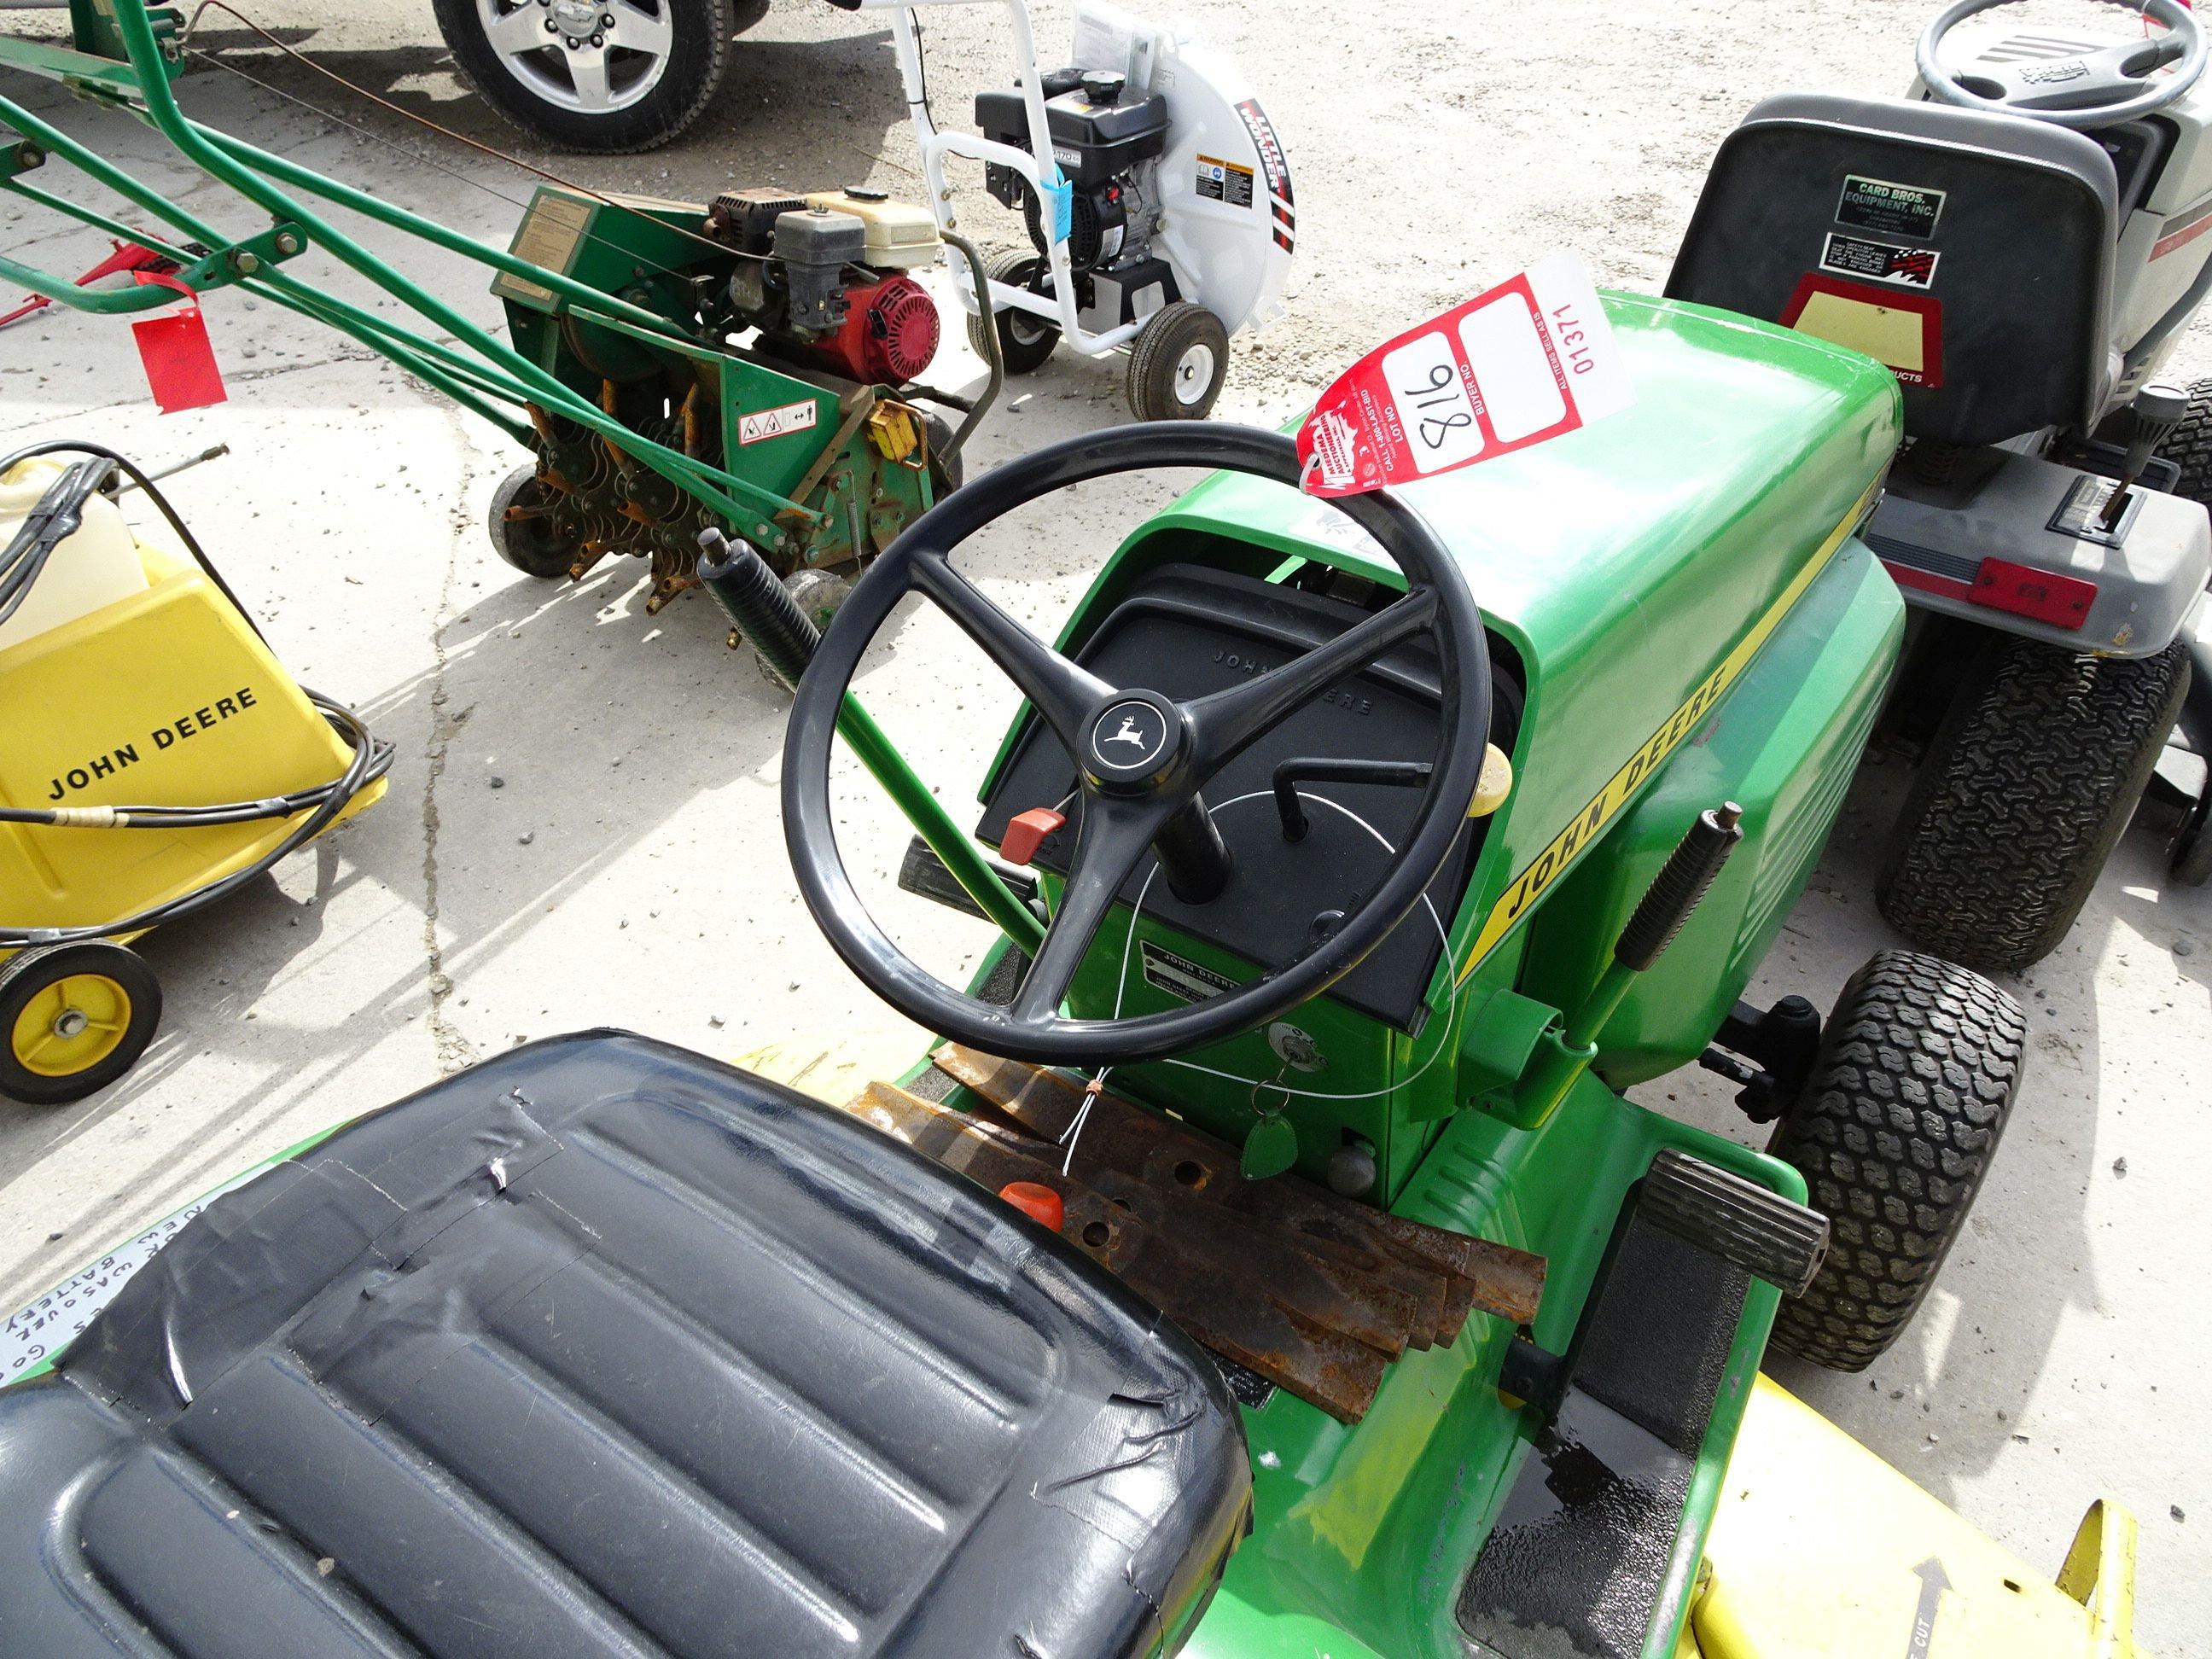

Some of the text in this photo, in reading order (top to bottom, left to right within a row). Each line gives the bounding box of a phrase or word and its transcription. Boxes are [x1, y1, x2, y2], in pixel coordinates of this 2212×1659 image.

[1241, 108, 1279, 189] WONDER
[1254, 116, 1286, 178] LITTLE
[1845, 191, 1908, 213] EQUIPMENT,
[1912, 204, 1934, 217] INC.
[1860, 183, 1925, 204] CARD BROS.
[1534, 311, 1569, 390] ALL ITEMS SELL AS IS
[1553, 304, 1594, 374] 01371
[1458, 360, 1485, 416] BUYER NO.
[1319, 415, 1345, 475] AUCTIONEERING
[1359, 389, 1394, 472] CALL 1-800-LAST-BID
[1383, 403, 1404, 443] LOT NO.
[1316, 434, 1336, 475] MIEDEMA
[49, 687, 258, 800] JOHN DEERE
[1509, 665, 1726, 919] JOHN DEERE
[1163, 953, 1195, 972] JOHN
[6, 1256, 115, 1333] BATTERY
[1914, 1617, 1930, 1648] CUT
